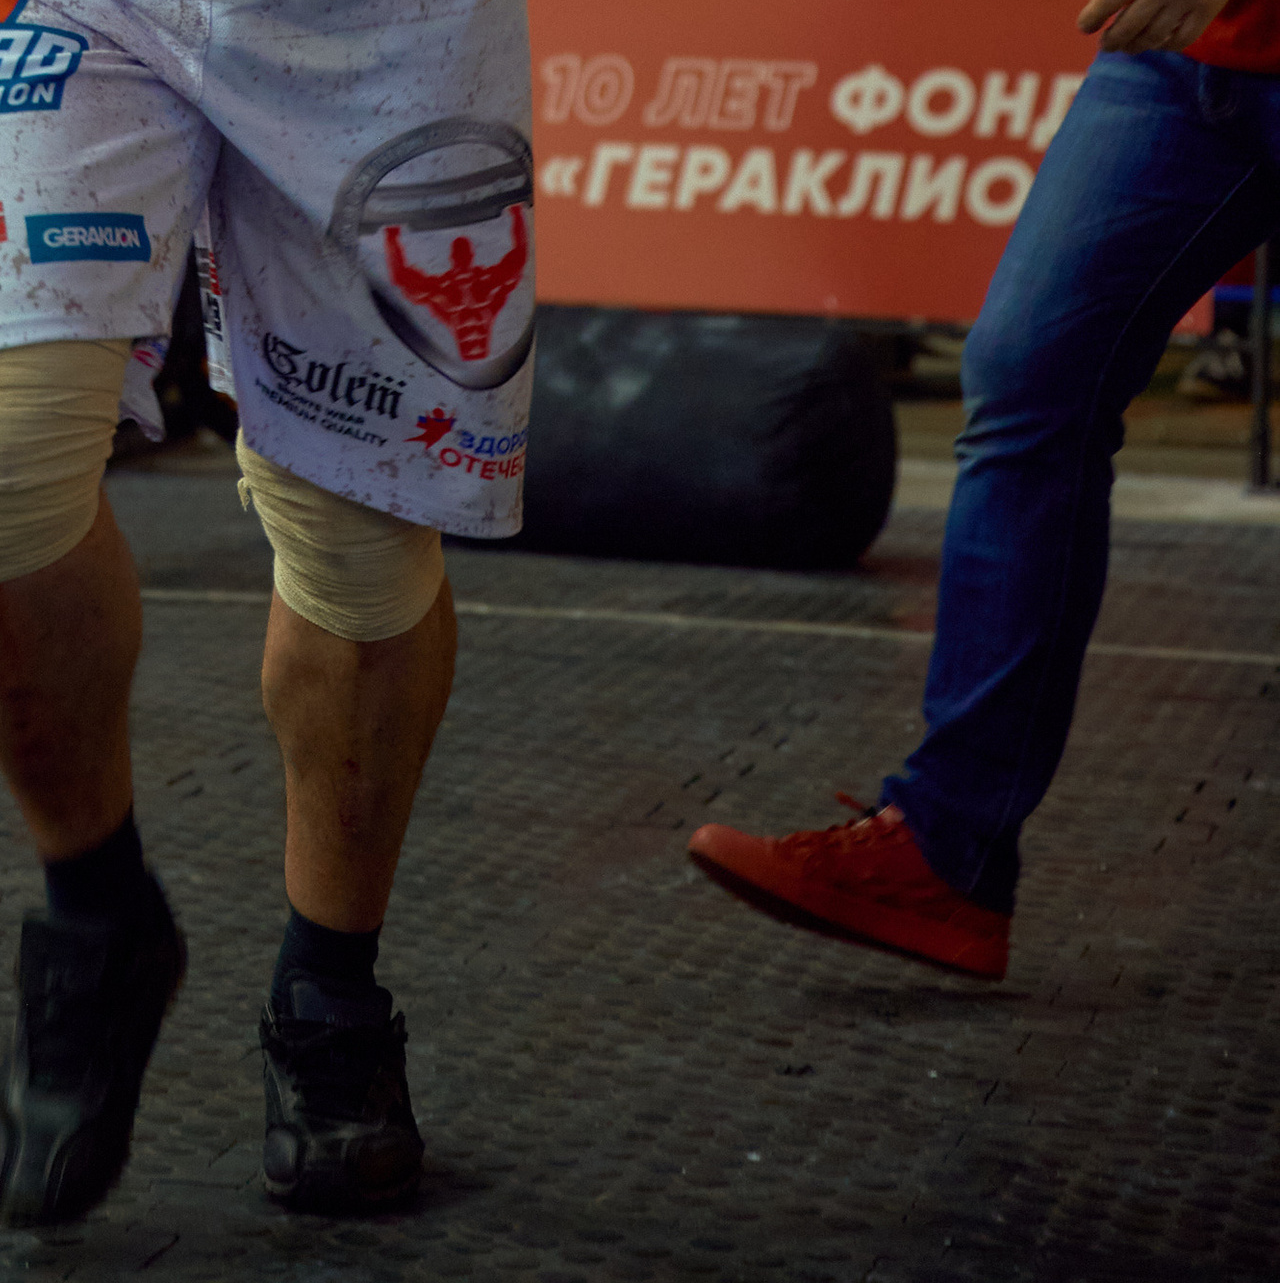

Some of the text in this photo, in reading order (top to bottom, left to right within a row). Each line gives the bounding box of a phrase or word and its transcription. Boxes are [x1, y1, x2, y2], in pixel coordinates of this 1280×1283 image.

[540, 53, 634, 125] 10
[644, 58, 818, 131] ЛЕТ
[321, 418, 389, 447] QUALITY
